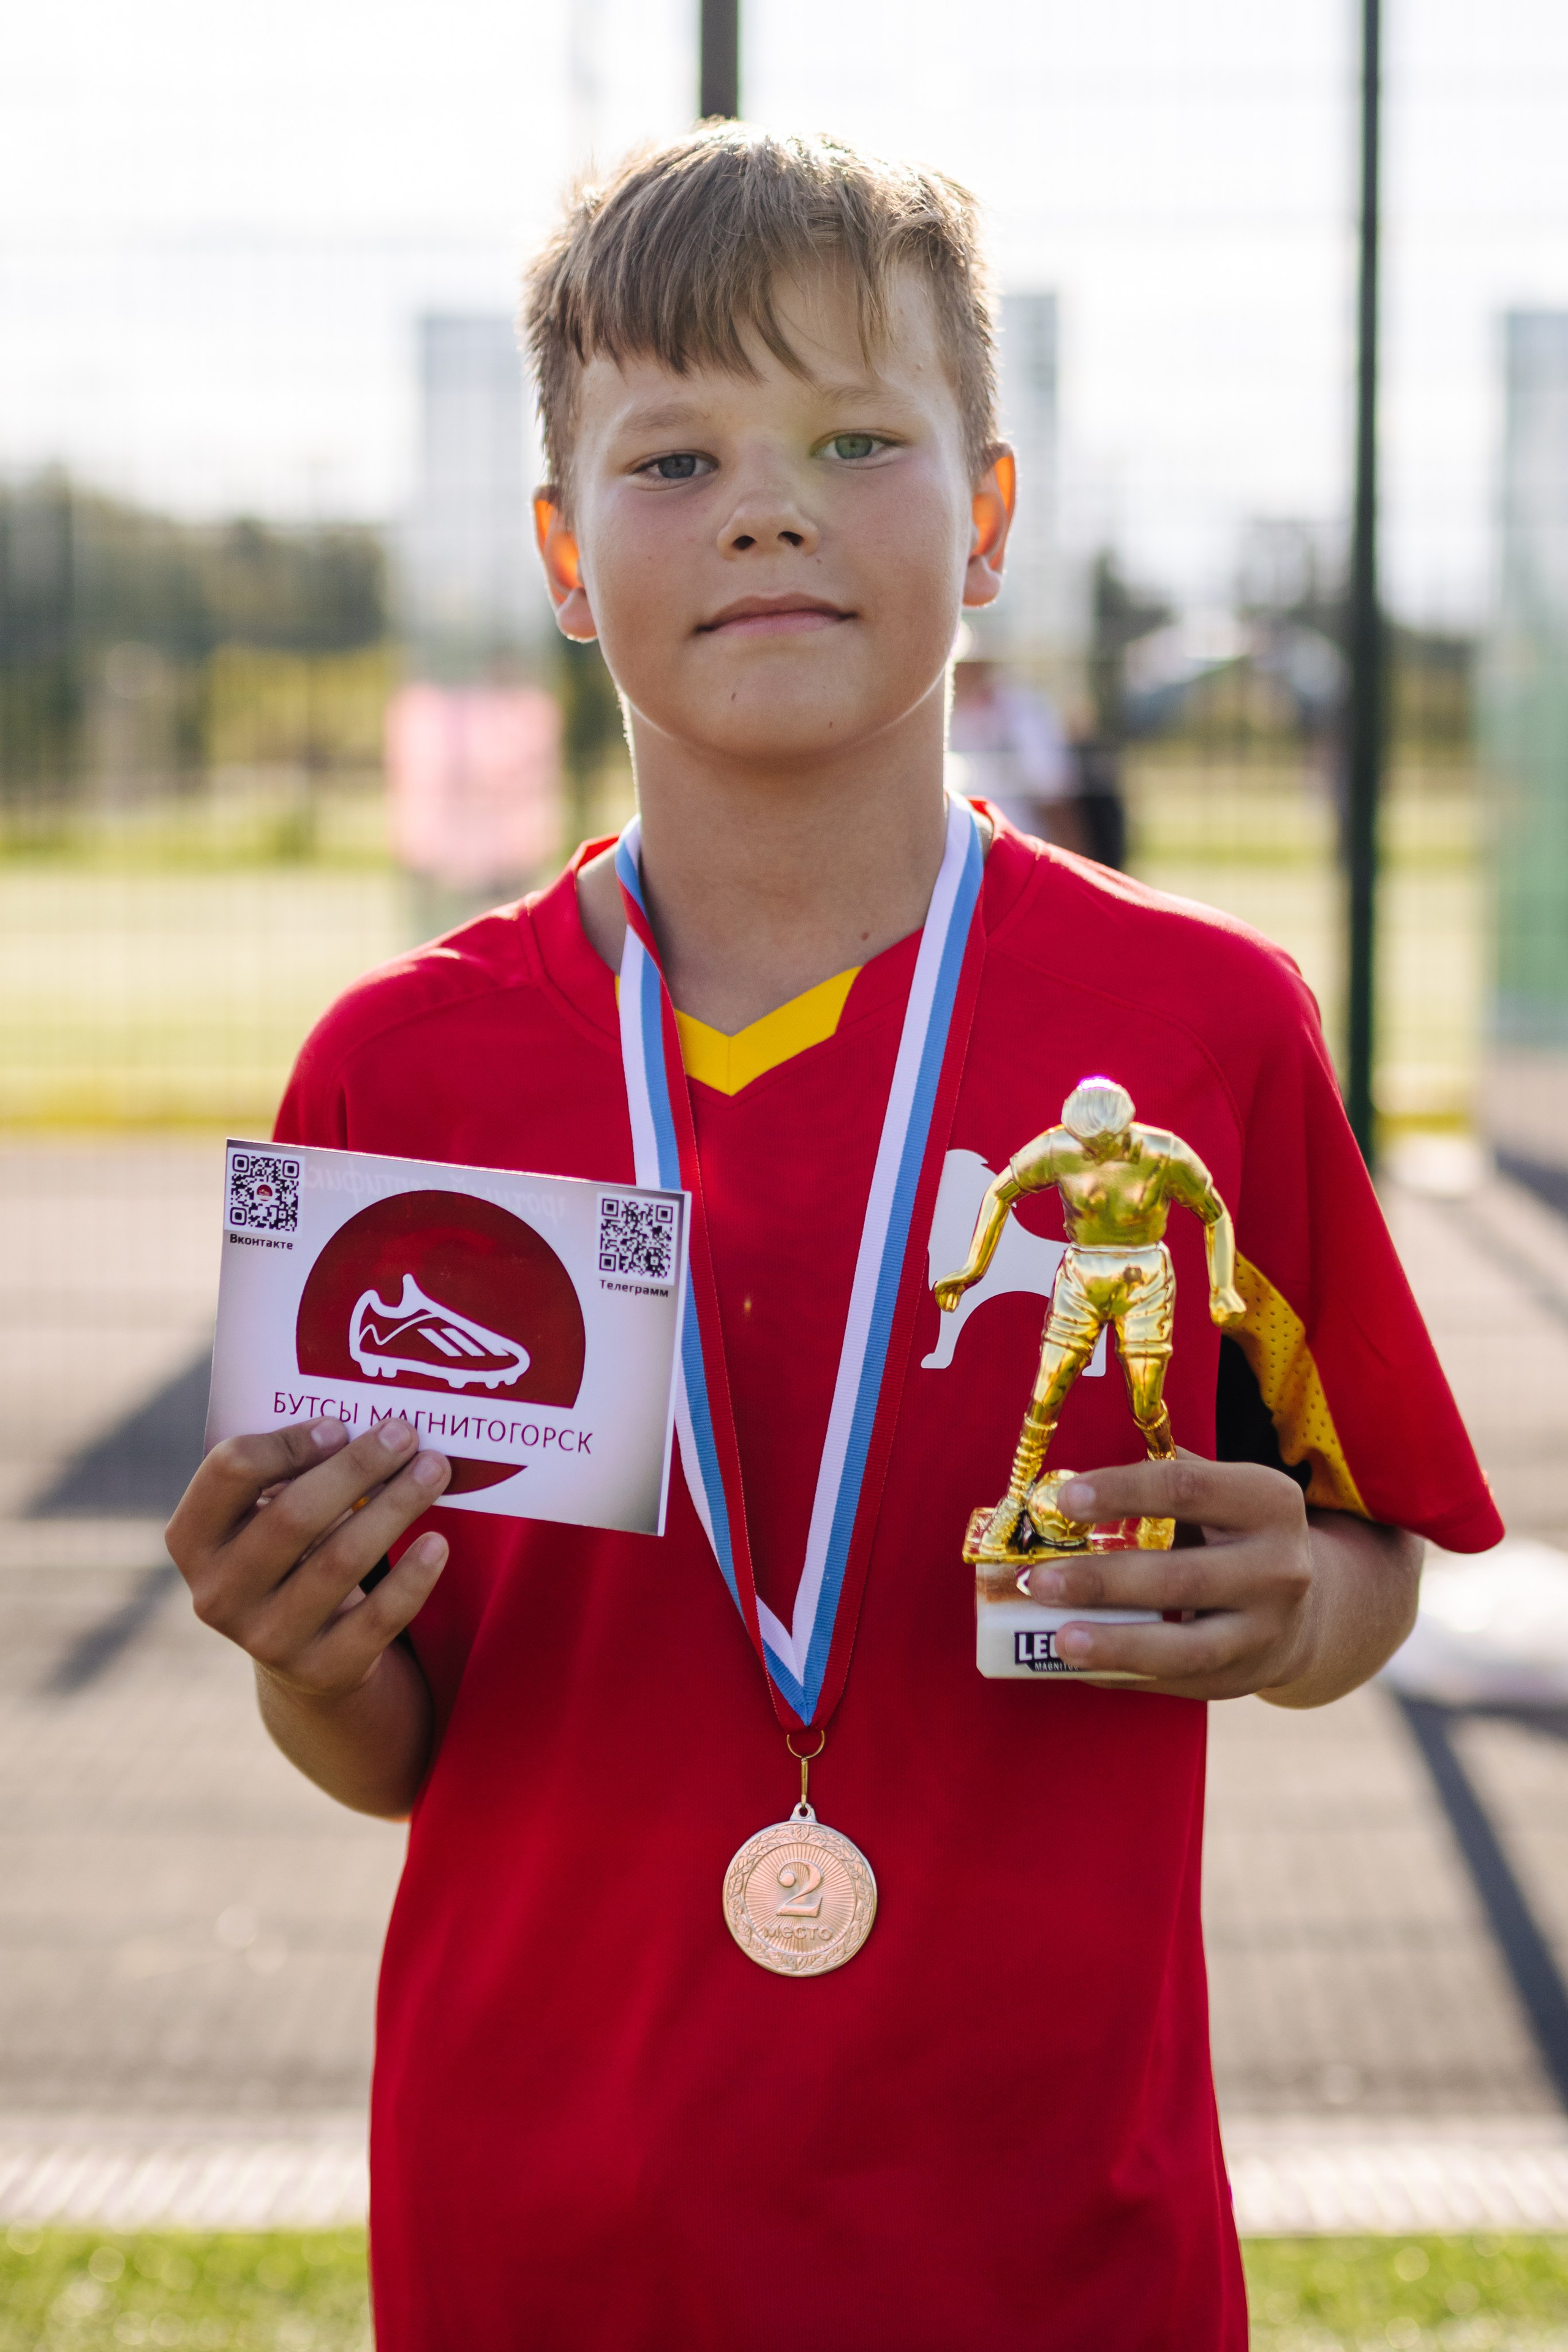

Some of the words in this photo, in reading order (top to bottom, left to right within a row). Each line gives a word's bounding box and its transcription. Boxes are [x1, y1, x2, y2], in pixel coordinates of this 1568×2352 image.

[228, 1234, 293, 1250] Вконтакте
[599, 1279, 669, 1298] Телеграмм
[274, 1392, 358, 1424] БУТСЫ
[777, 1860, 824, 1918] 2
